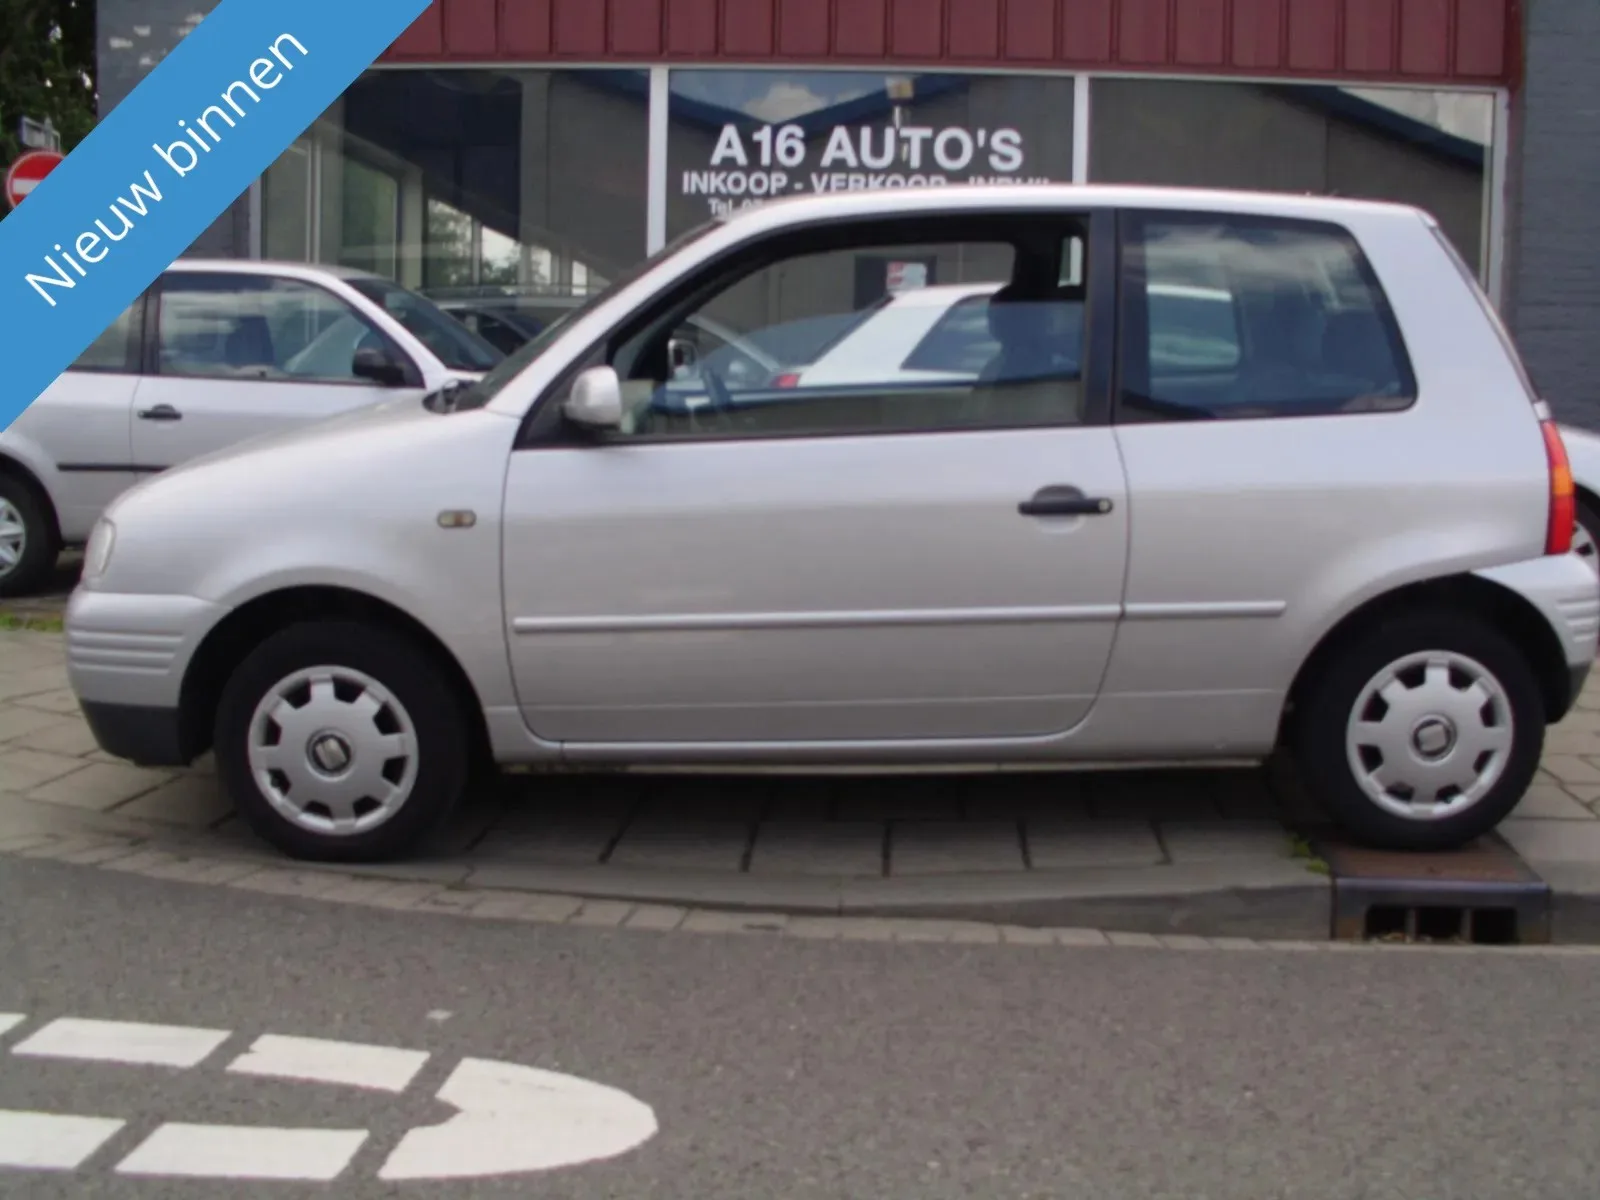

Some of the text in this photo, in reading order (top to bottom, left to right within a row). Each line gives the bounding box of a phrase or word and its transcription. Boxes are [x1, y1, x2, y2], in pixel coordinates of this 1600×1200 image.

[711, 124, 1023, 171] A16 AUTO'S
[682, 170, 788, 195] INKOOP
